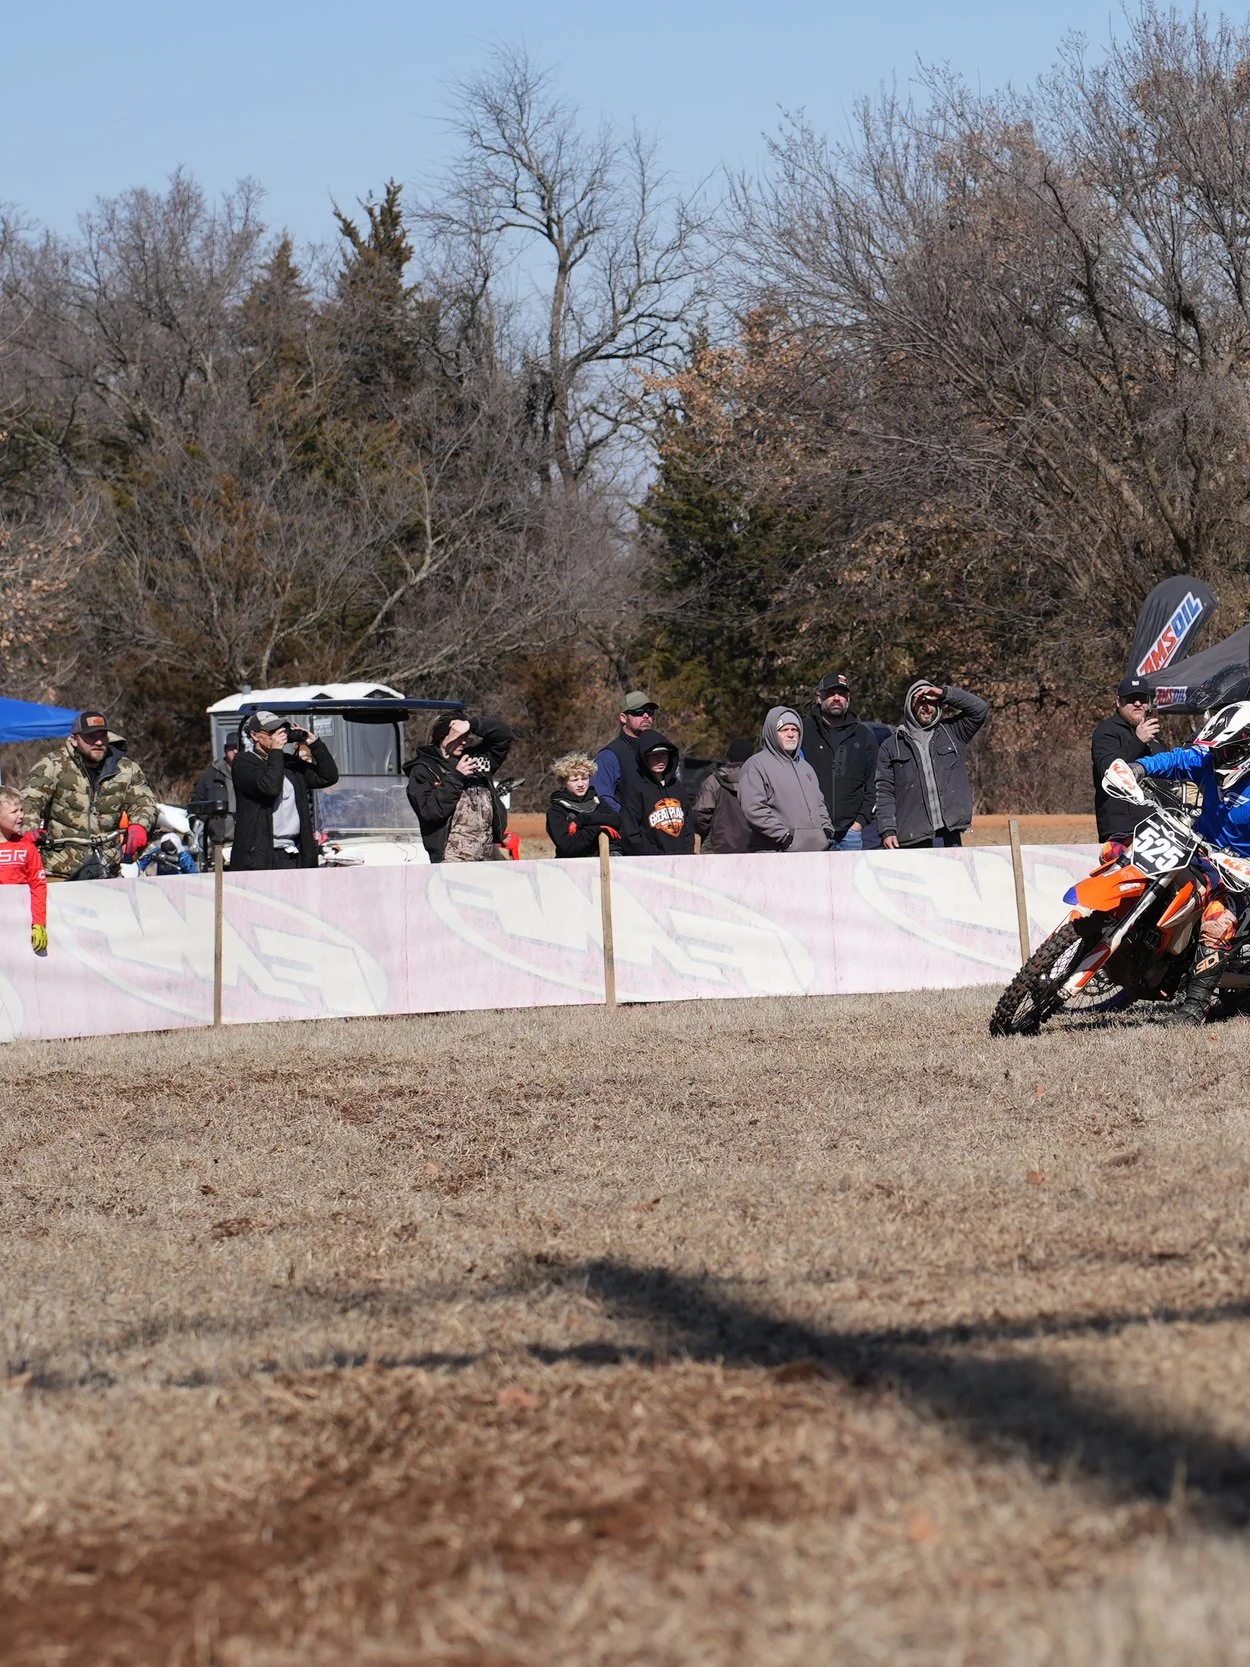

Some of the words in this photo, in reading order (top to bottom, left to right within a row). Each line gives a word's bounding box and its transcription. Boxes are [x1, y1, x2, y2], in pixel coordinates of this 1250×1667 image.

[1138, 592, 1203, 676] AMSOIL
[1155, 687, 1187, 704] AMSOIL
[1134, 830, 1187, 873] 525
